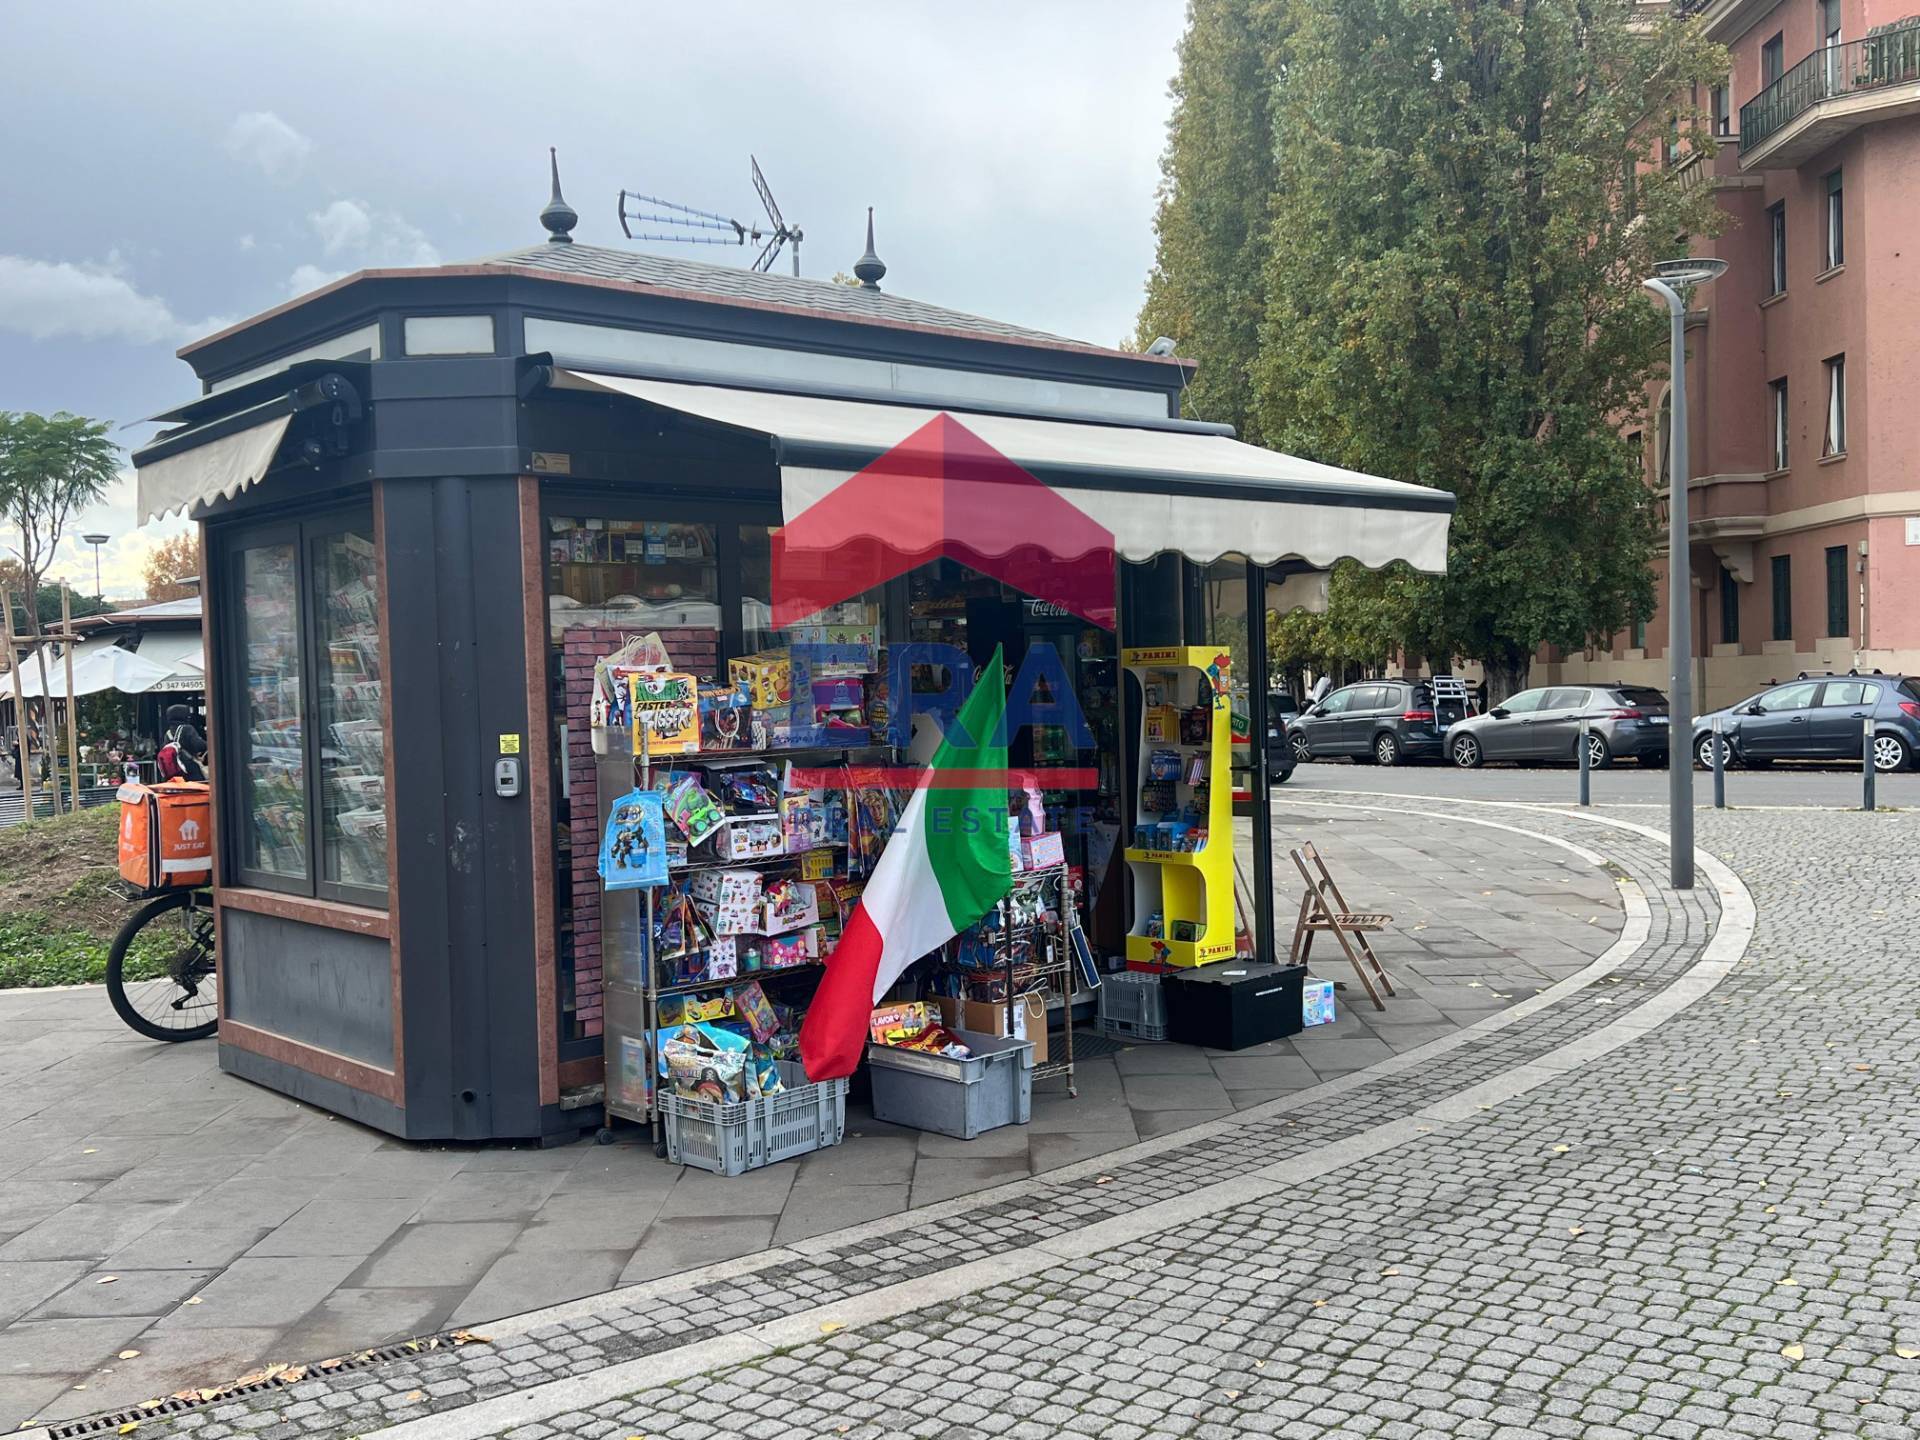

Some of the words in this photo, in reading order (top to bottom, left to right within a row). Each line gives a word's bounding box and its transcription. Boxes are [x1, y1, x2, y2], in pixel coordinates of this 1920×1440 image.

[1142, 651, 1176, 660] PANINI
[636, 702, 672, 711] FASTER
[174, 843, 191, 851] JUST
[1208, 945, 1232, 955] PANINI
